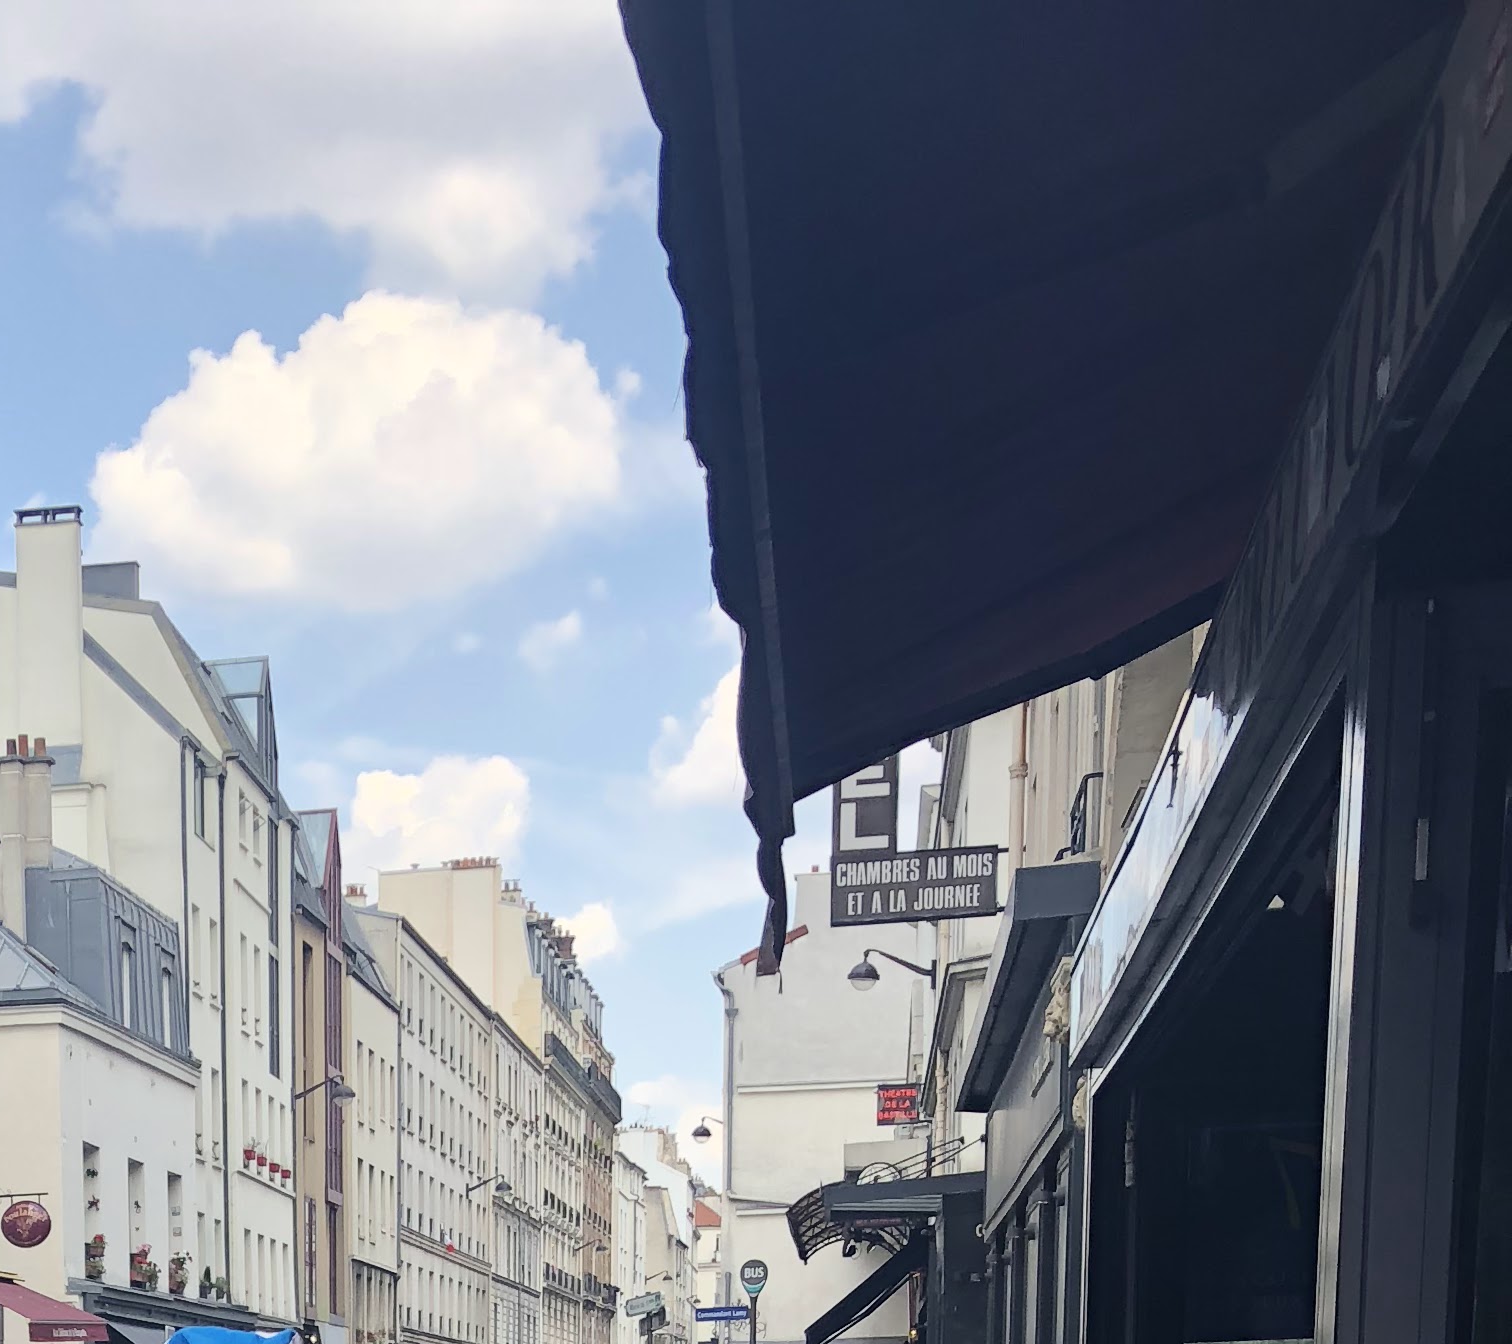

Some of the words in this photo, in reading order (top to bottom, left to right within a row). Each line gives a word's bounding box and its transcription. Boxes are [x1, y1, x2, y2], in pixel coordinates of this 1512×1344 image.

[836, 858, 920, 887] CHAMBRES
[927, 856, 947, 880] AU
[953, 853, 993, 879] MOIS
[847, 892, 864, 916] ET
[871, 890, 882, 914] A
[889, 889, 907, 913] LA
[913, 884, 981, 911] JOURNEE
[744, 1267, 764, 1279] BUS
[697, 1310, 731, 1319] Commandant
[733, 1309, 747, 1318] Lamy
